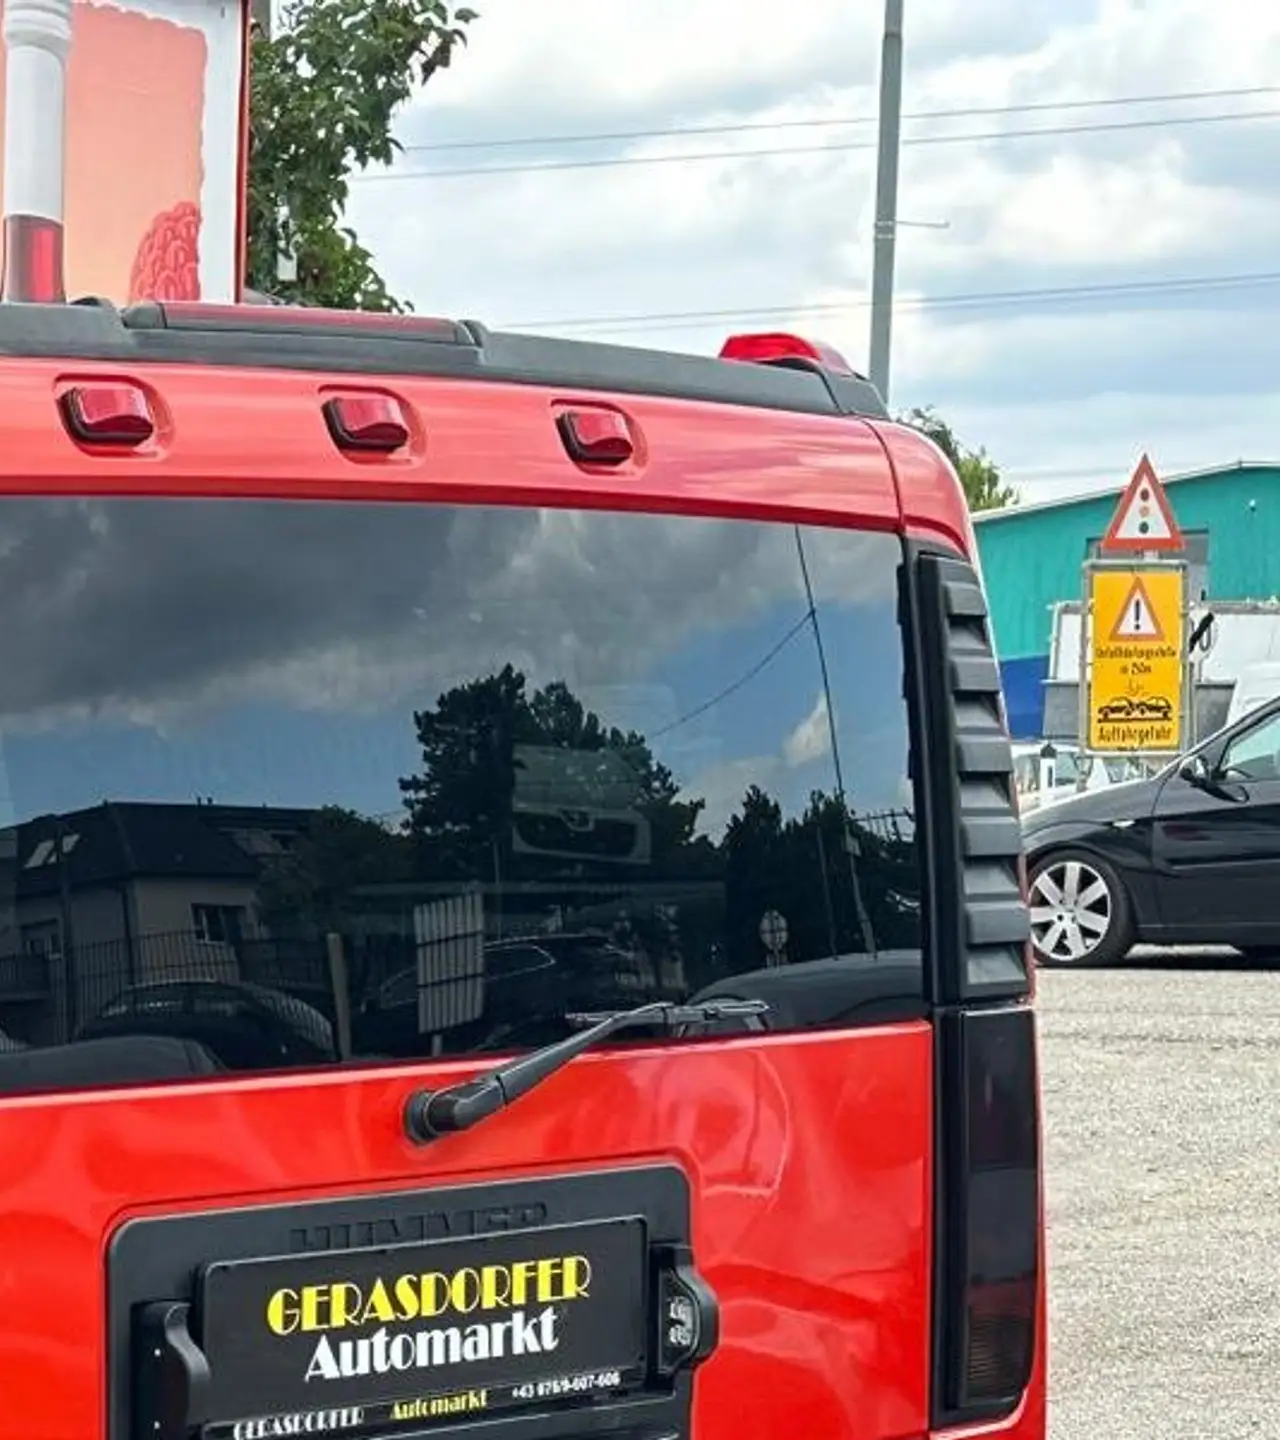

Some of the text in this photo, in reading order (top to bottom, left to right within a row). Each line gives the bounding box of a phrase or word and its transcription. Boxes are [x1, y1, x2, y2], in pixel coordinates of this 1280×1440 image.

[266, 1254, 592, 1337] GERASDORFER
[304, 1304, 560, 1384] Automarkt
[390, 1388, 488, 1421] Automarkt
